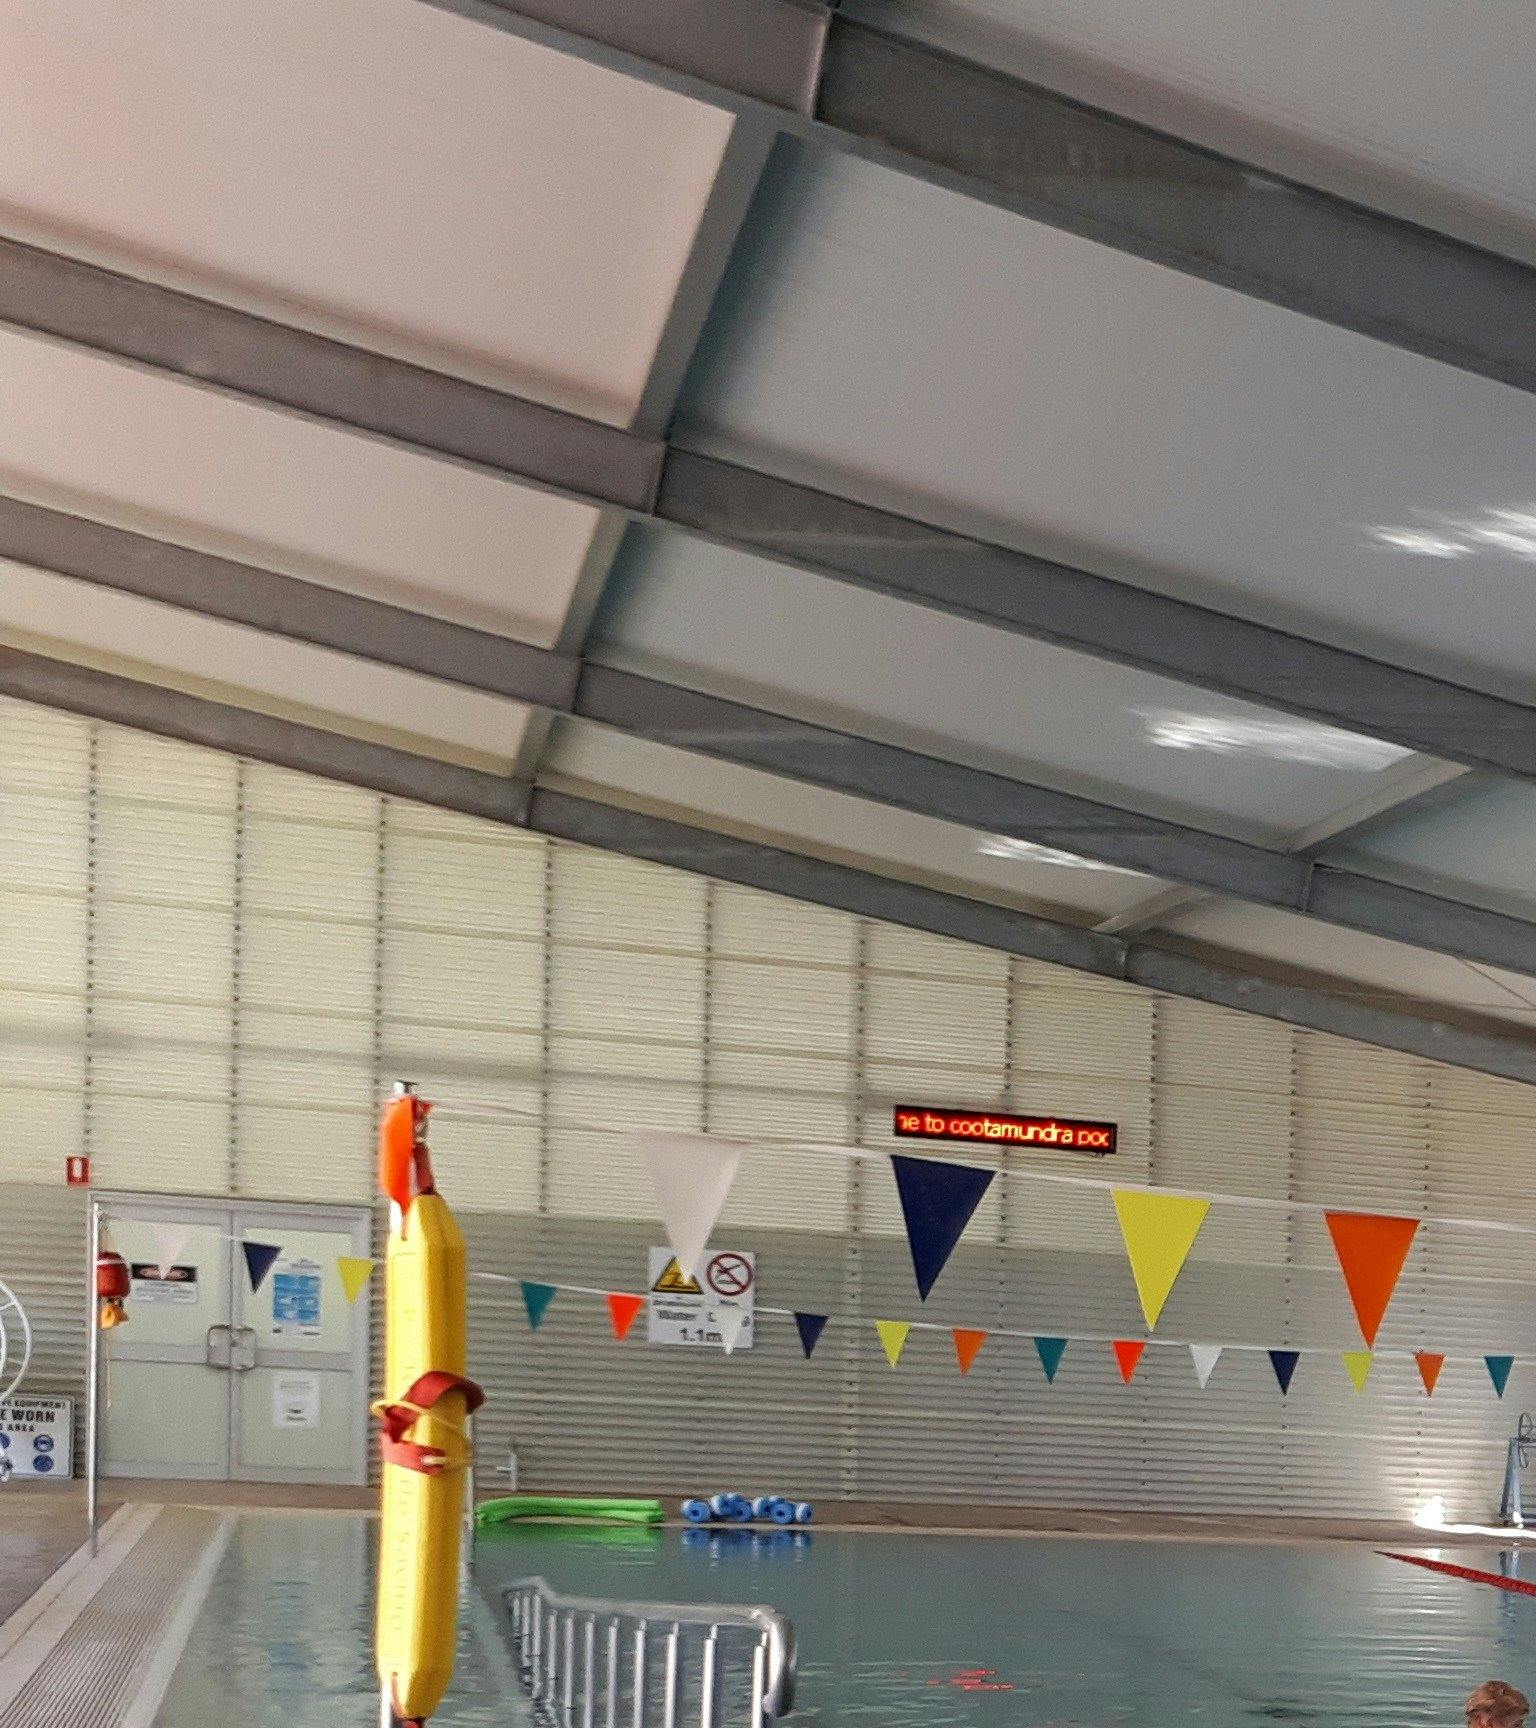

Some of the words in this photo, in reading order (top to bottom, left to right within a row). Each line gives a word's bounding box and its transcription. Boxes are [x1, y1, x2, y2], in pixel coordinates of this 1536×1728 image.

[925, 1112, 945, 1133] to
[950, 1118, 1073, 1144] cootamundra
[12, 1409, 55, 1422] WORN
